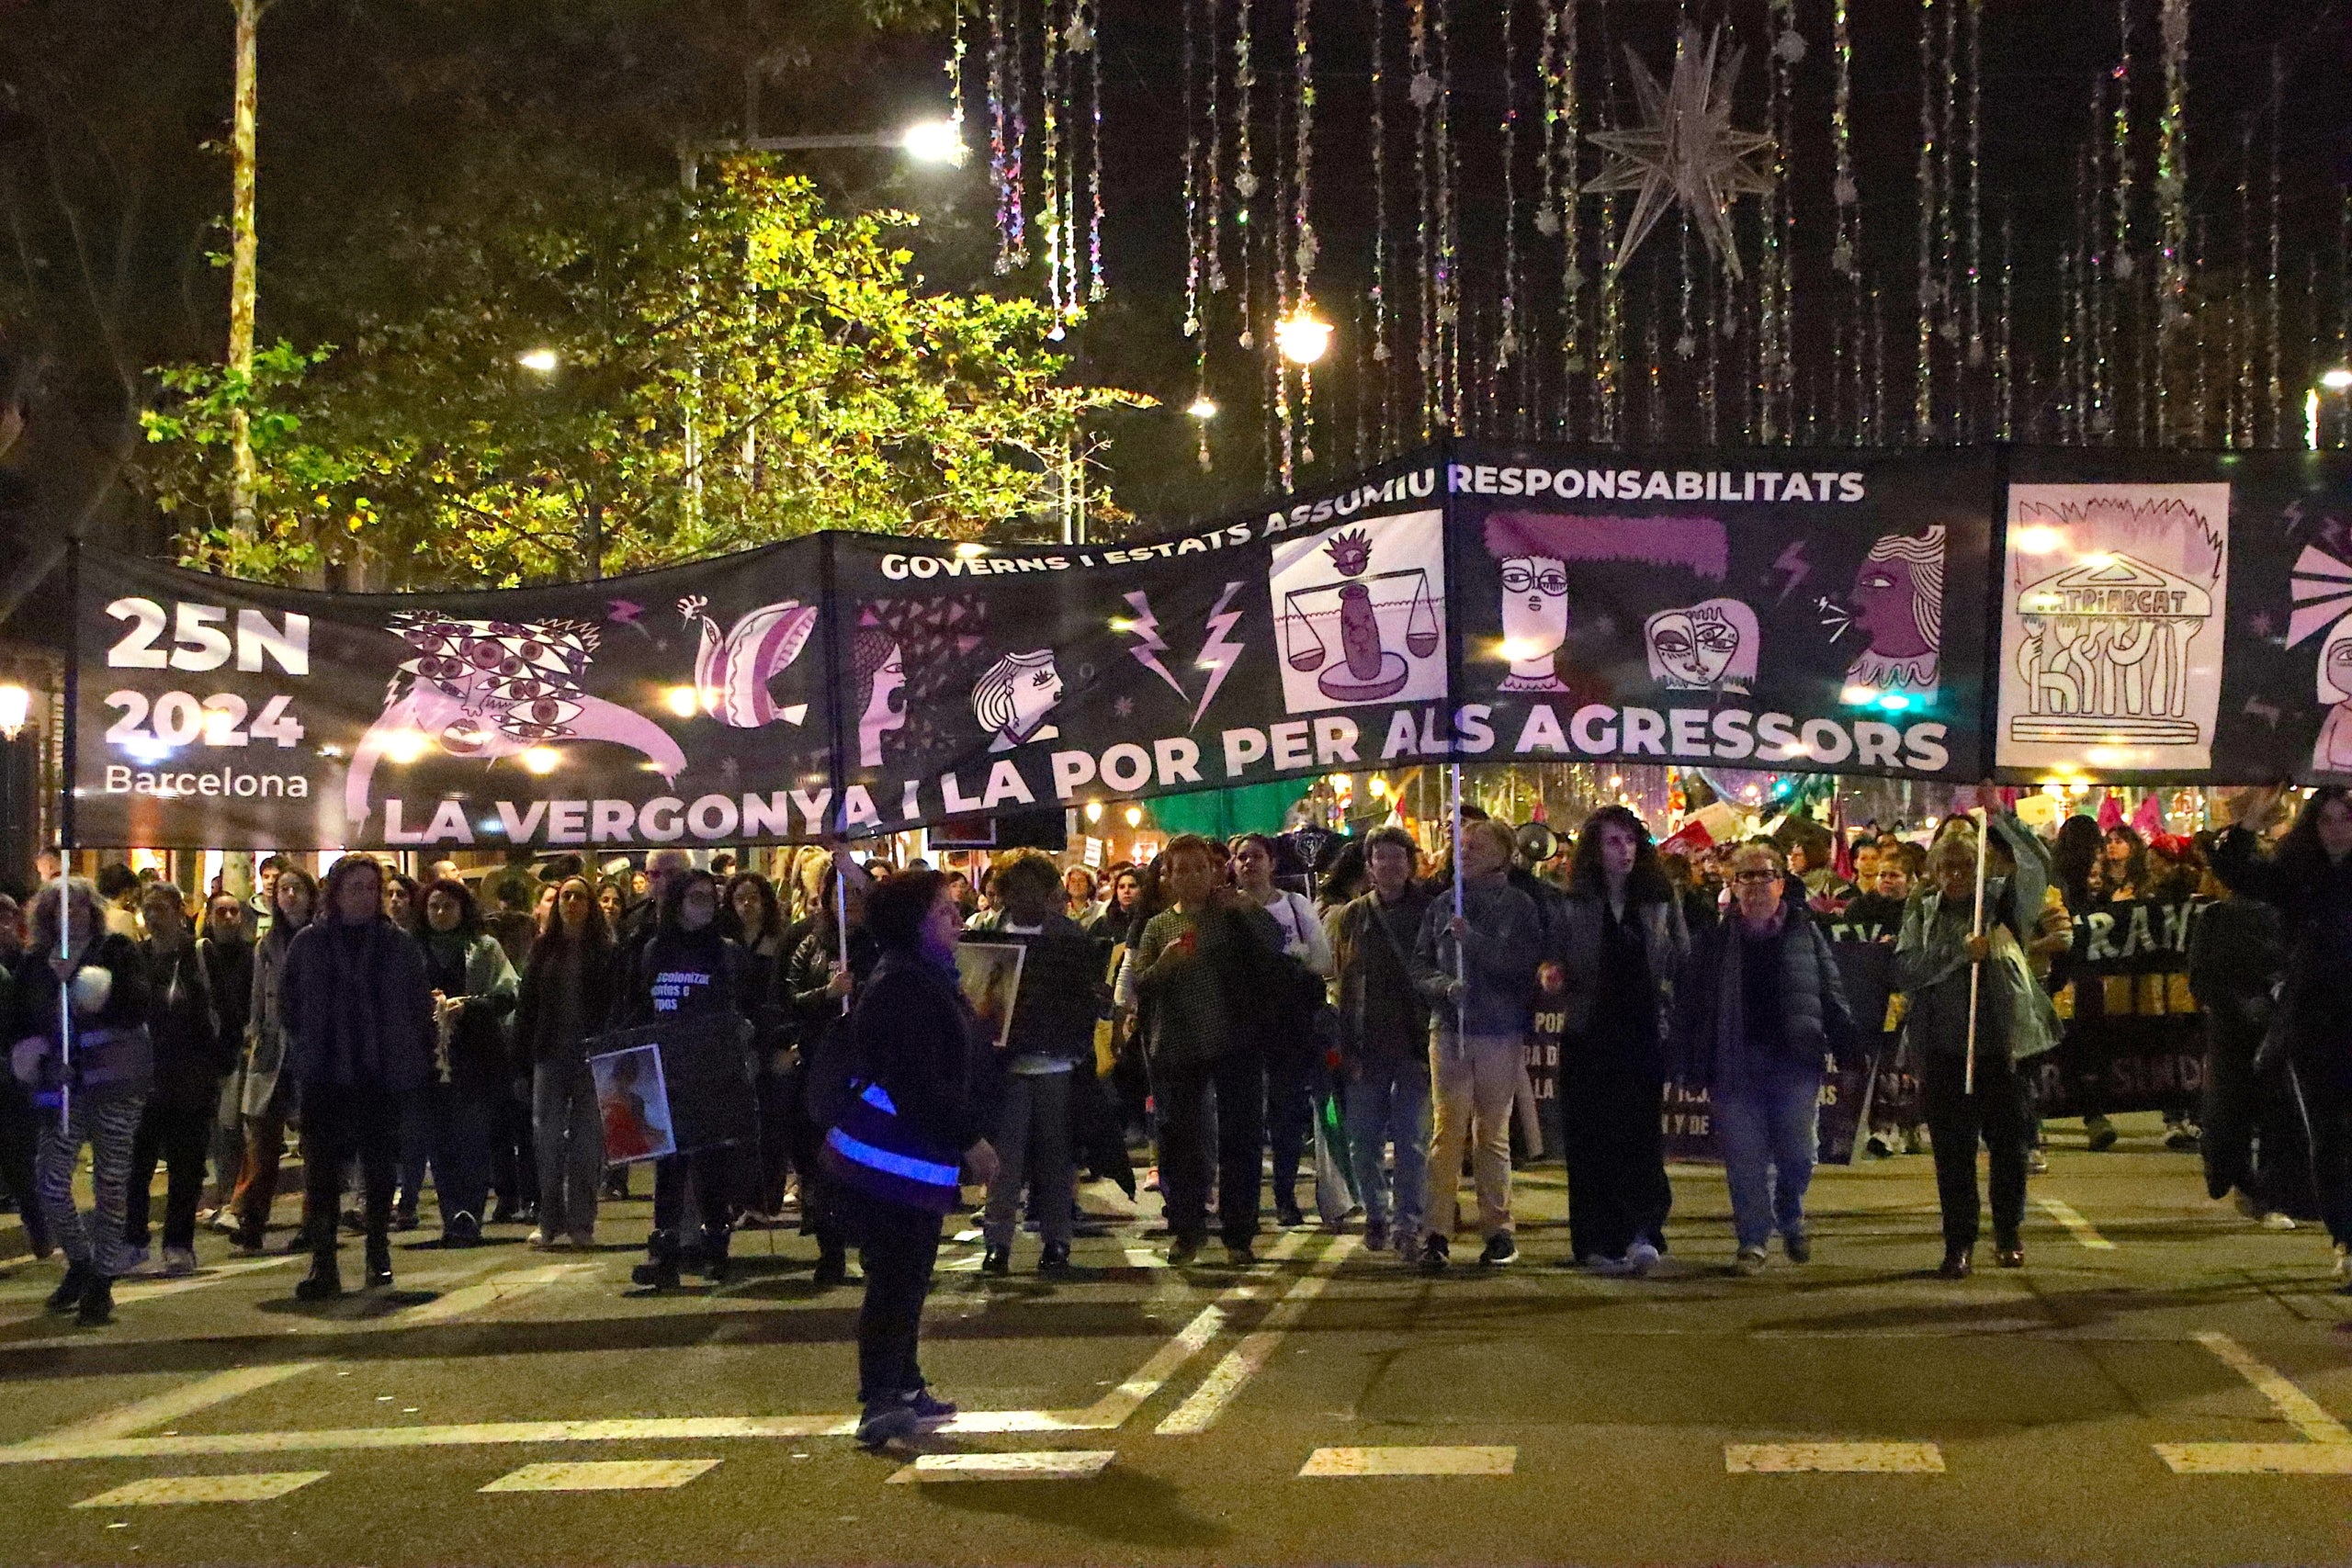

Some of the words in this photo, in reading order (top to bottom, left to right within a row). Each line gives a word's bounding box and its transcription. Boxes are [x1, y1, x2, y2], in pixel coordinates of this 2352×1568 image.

[881, 554, 1070, 581] GOVERNS
[1080, 555, 1095, 567] I
[1102, 522, 1251, 565] ESTATS
[1261, 468, 1435, 537] ASSUMIU
[1447, 464, 1865, 502] RESPONSABILITATS
[106, 597, 311, 675] 25N
[104, 690, 305, 748] 2024
[106, 765, 309, 799] Barcelona
[384, 799, 475, 844] LA
[496, 784, 884, 844] VERGONYA
[902, 780, 920, 820] I
[940, 760, 1035, 814] LA
[1051, 737, 1203, 800] POR
[1222, 716, 1361, 778] PER
[1380, 704, 1492, 761] ALS
[1514, 704, 1950, 771] AGRESSORS
